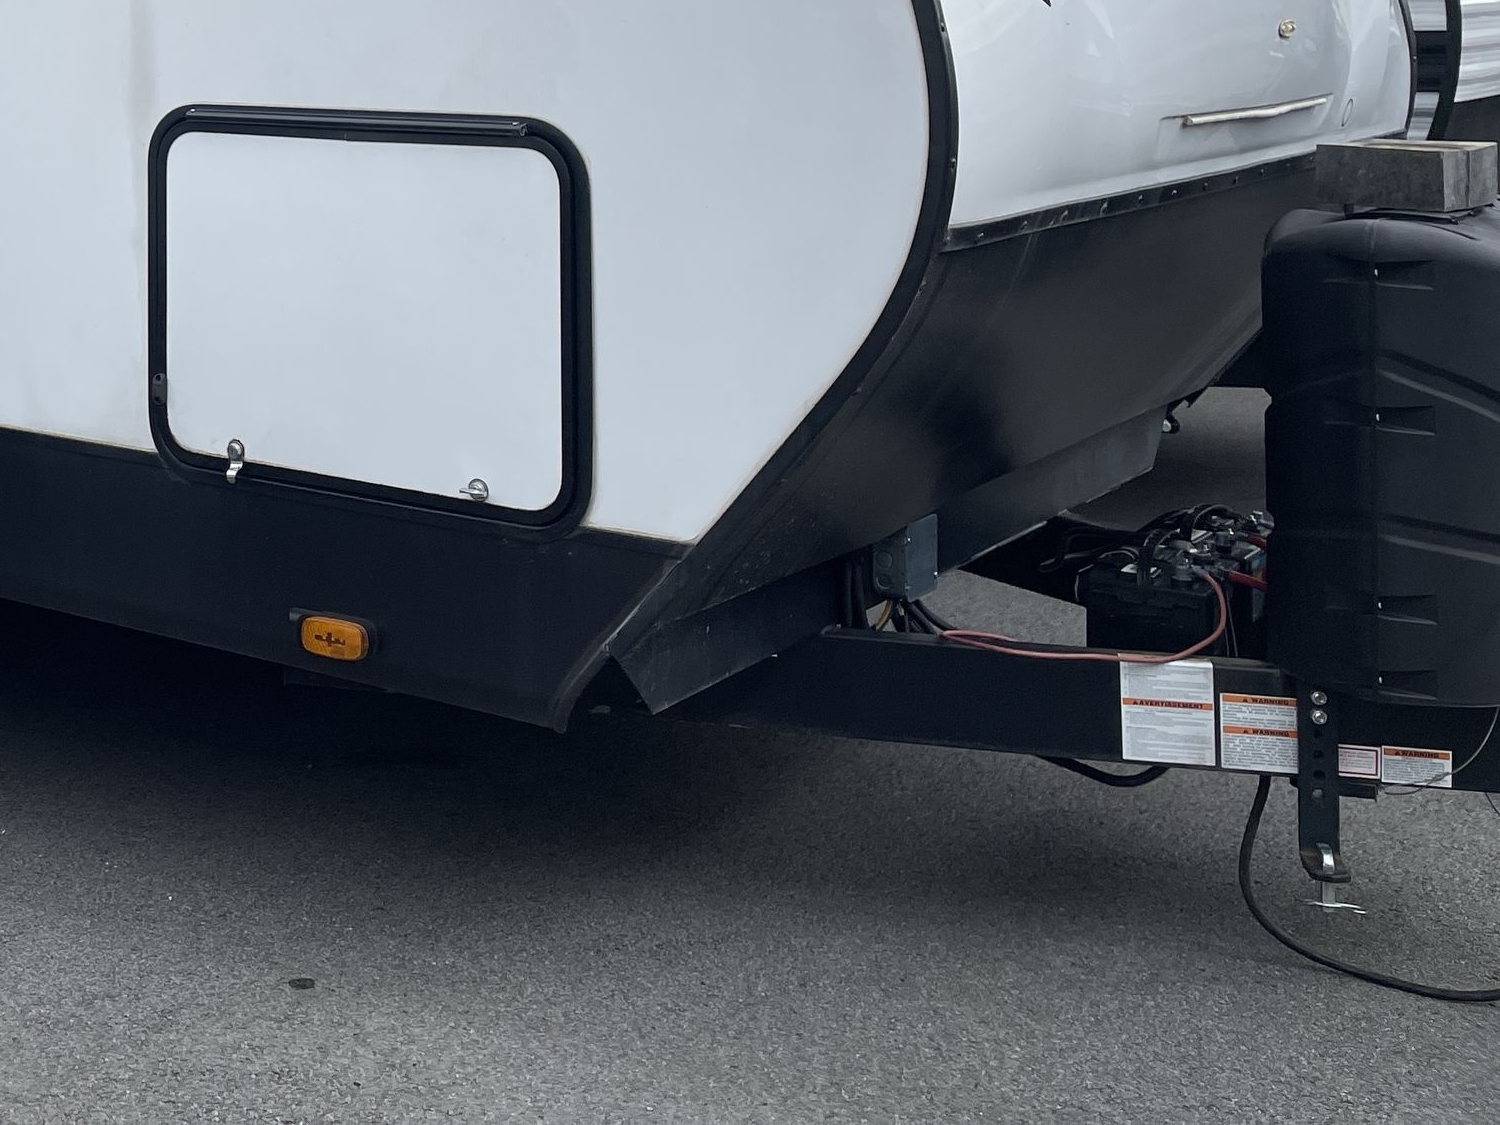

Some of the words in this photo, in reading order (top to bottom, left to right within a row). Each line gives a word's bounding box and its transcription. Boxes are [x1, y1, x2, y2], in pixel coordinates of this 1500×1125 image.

[1139, 700, 1204, 710] AVERTISSEMENT
[1251, 697, 1289, 706] WARNING
[1251, 728, 1290, 737] WARNING
